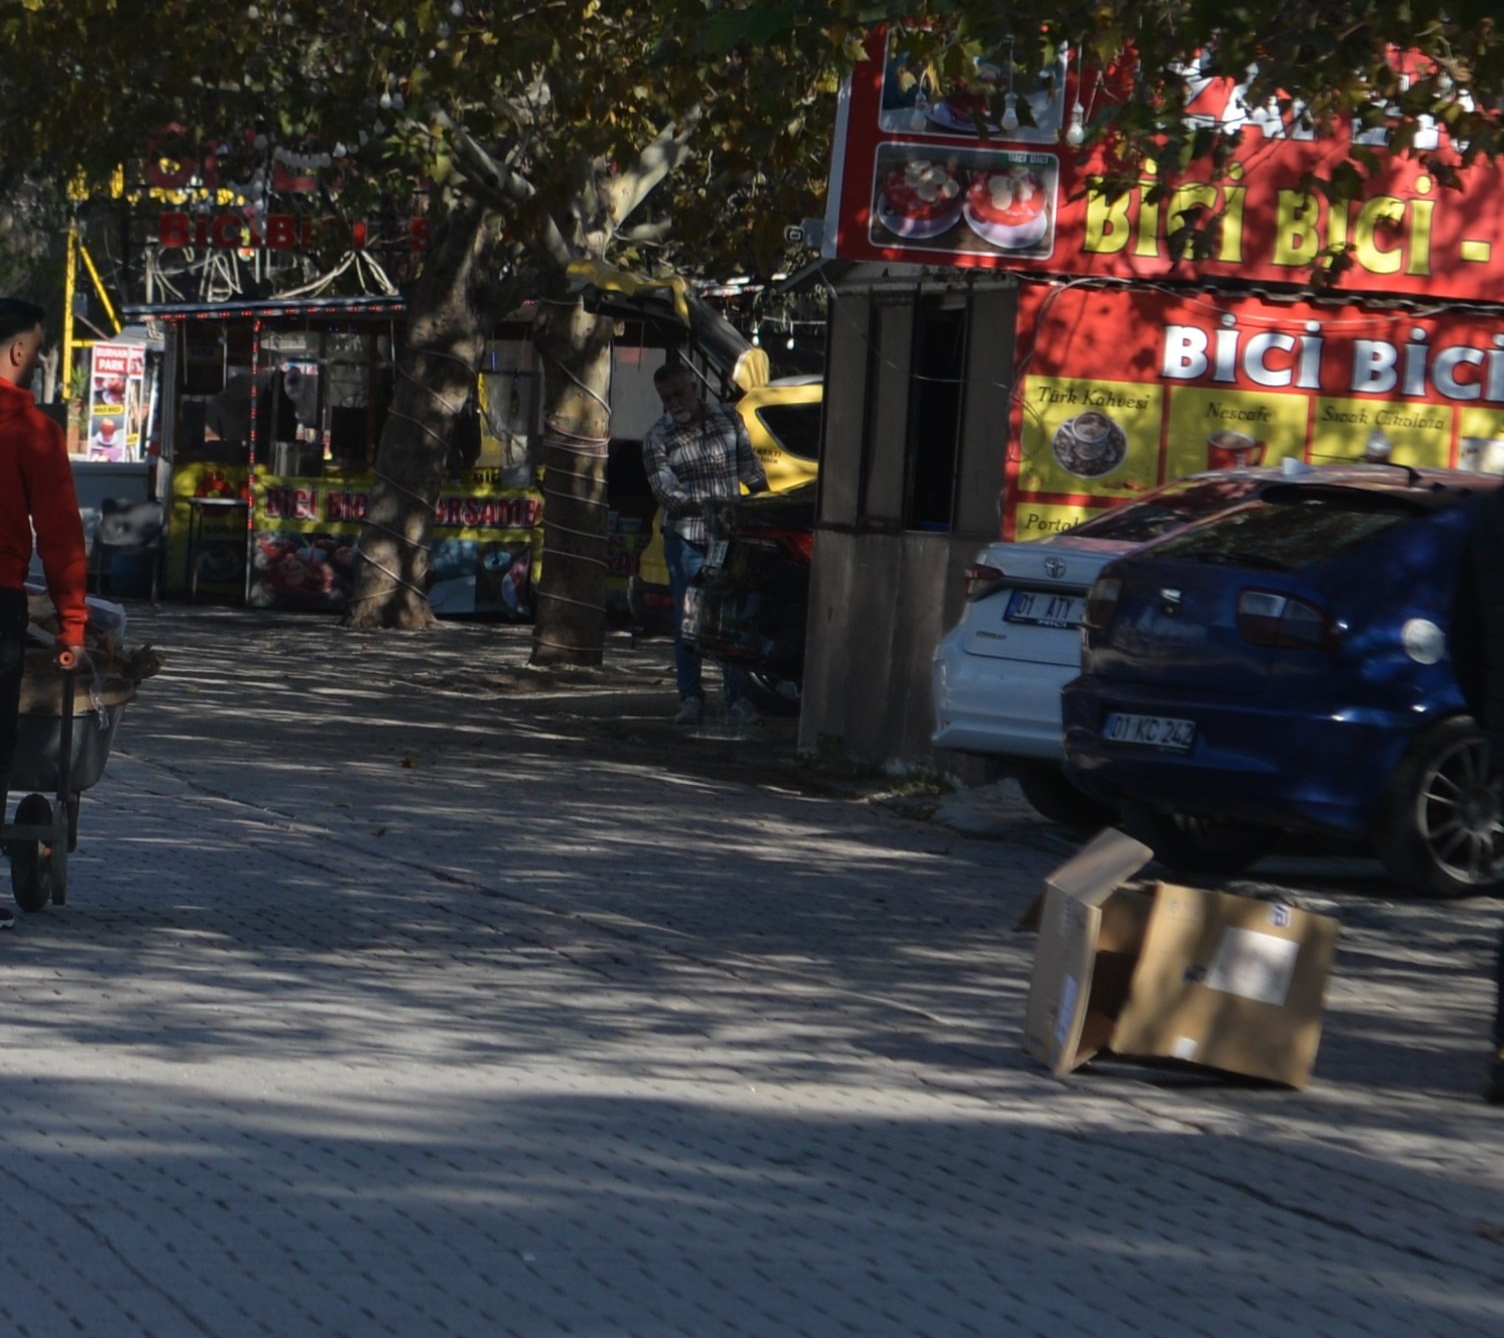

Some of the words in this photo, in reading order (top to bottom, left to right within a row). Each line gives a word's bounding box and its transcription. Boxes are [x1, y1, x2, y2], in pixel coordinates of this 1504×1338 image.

[1162, 313, 1325, 388] BİCİ
[99, 359, 124, 371] PARK
[1038, 386, 1076, 405] Türk
[1083, 389, 1151, 409] Kahvesi
[1112, 715, 1131, 739] 01
